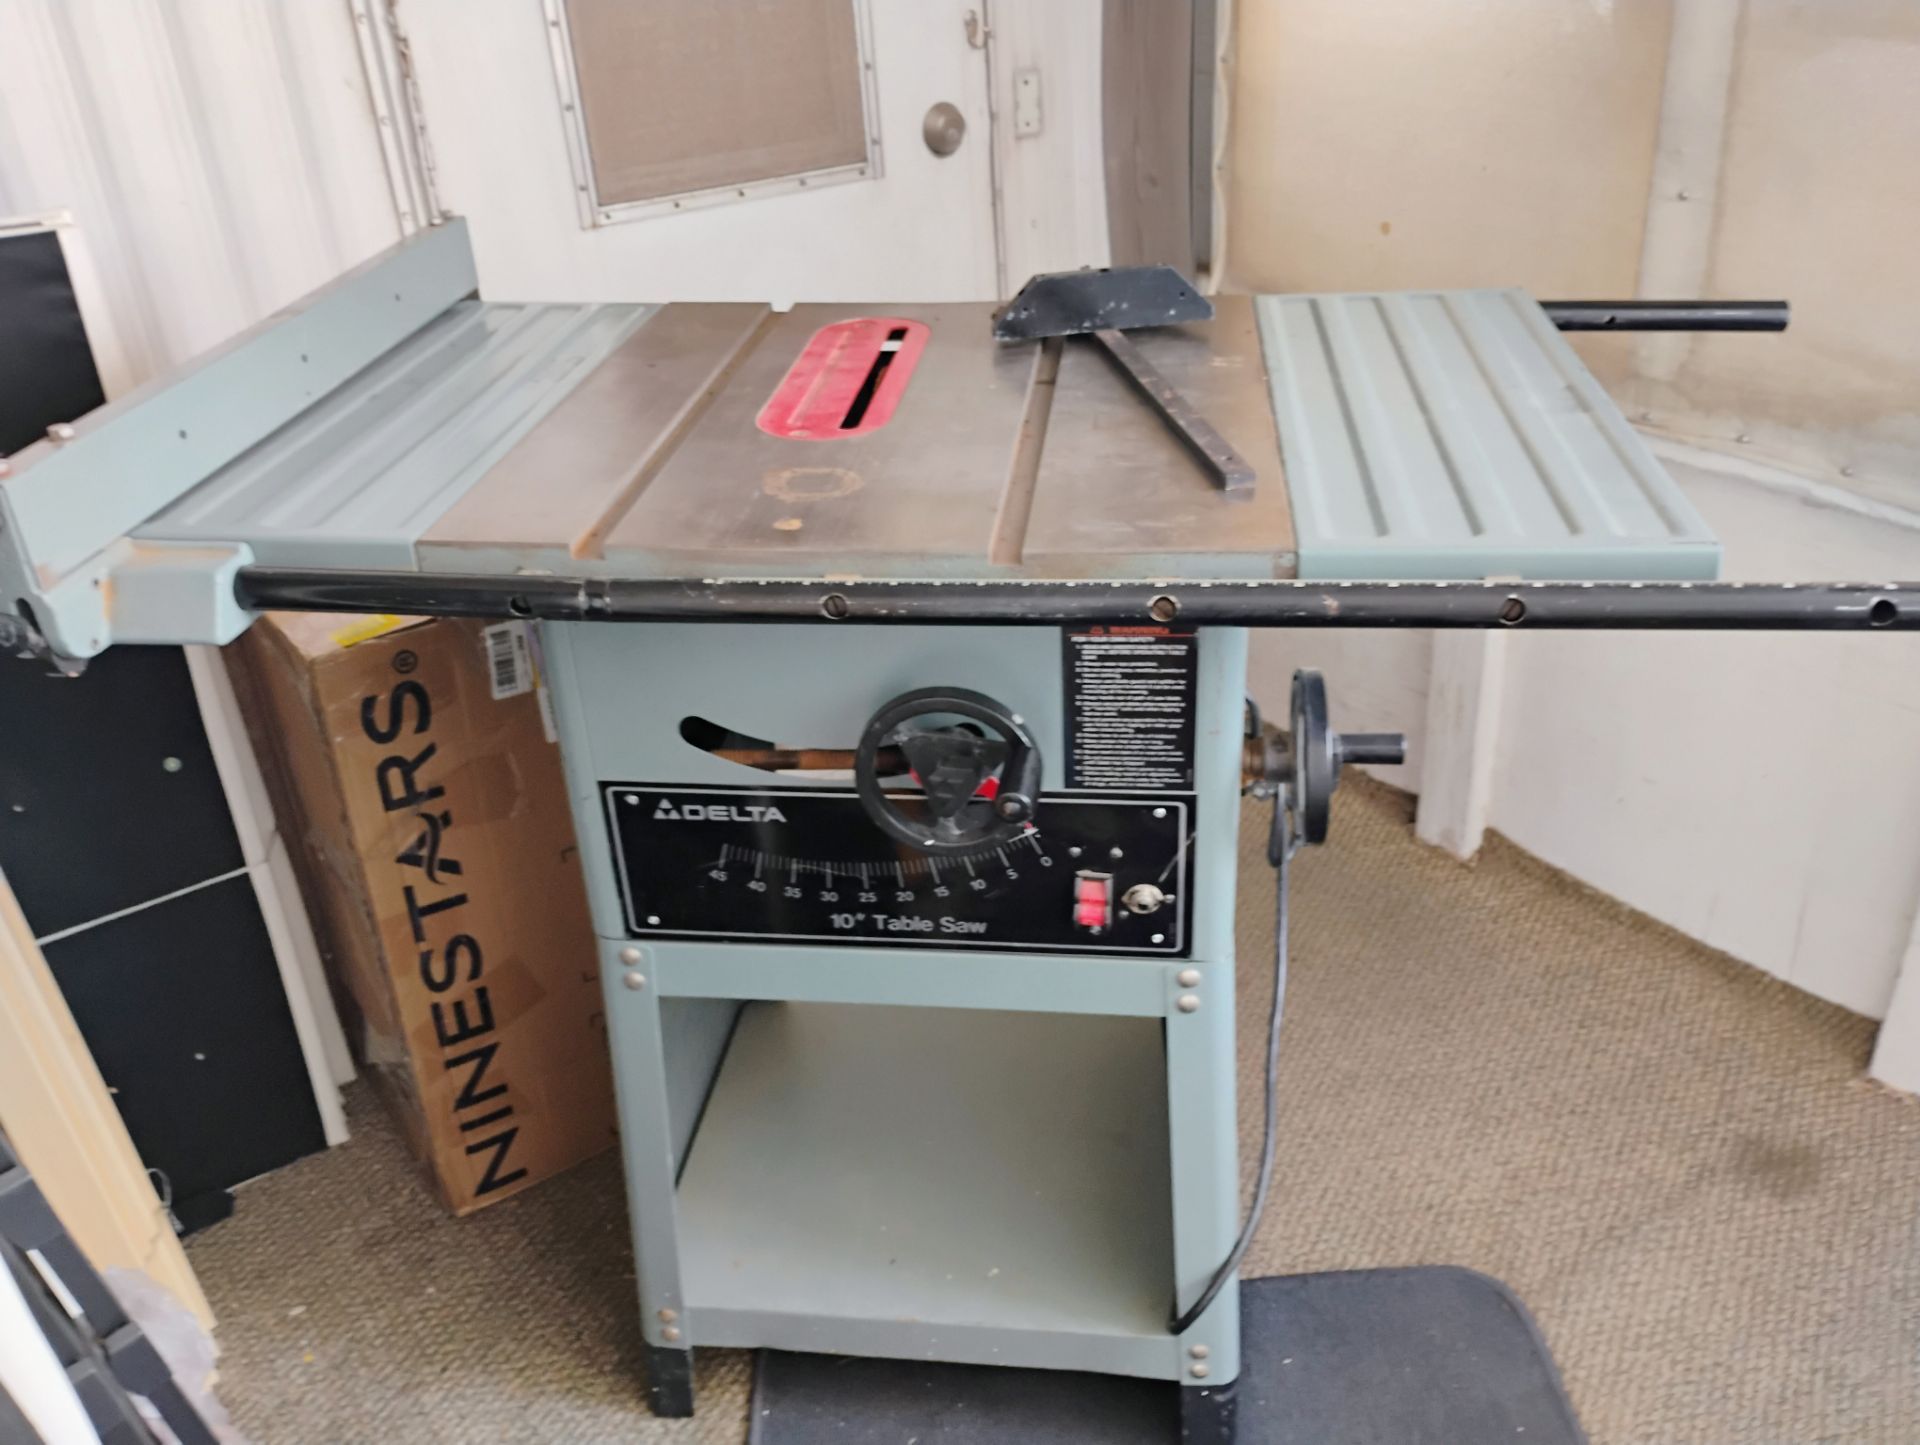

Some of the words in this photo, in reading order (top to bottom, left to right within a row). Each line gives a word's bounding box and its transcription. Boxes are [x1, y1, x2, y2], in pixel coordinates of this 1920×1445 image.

[681, 804, 787, 823] DELTA
[709, 869, 728, 882] 45
[747, 880, 767, 892] 40
[784, 886, 802, 898] 35
[821, 891, 839, 902] 30
[858, 891, 877, 902] 25
[896, 891, 915, 902] 20
[934, 886, 950, 898] 15
[970, 878, 987, 891] 10
[1006, 868, 1019, 880] 5
[1040, 855, 1053, 867] 0
[872, 914, 935, 933] Table
[939, 916, 987, 934] Saw
